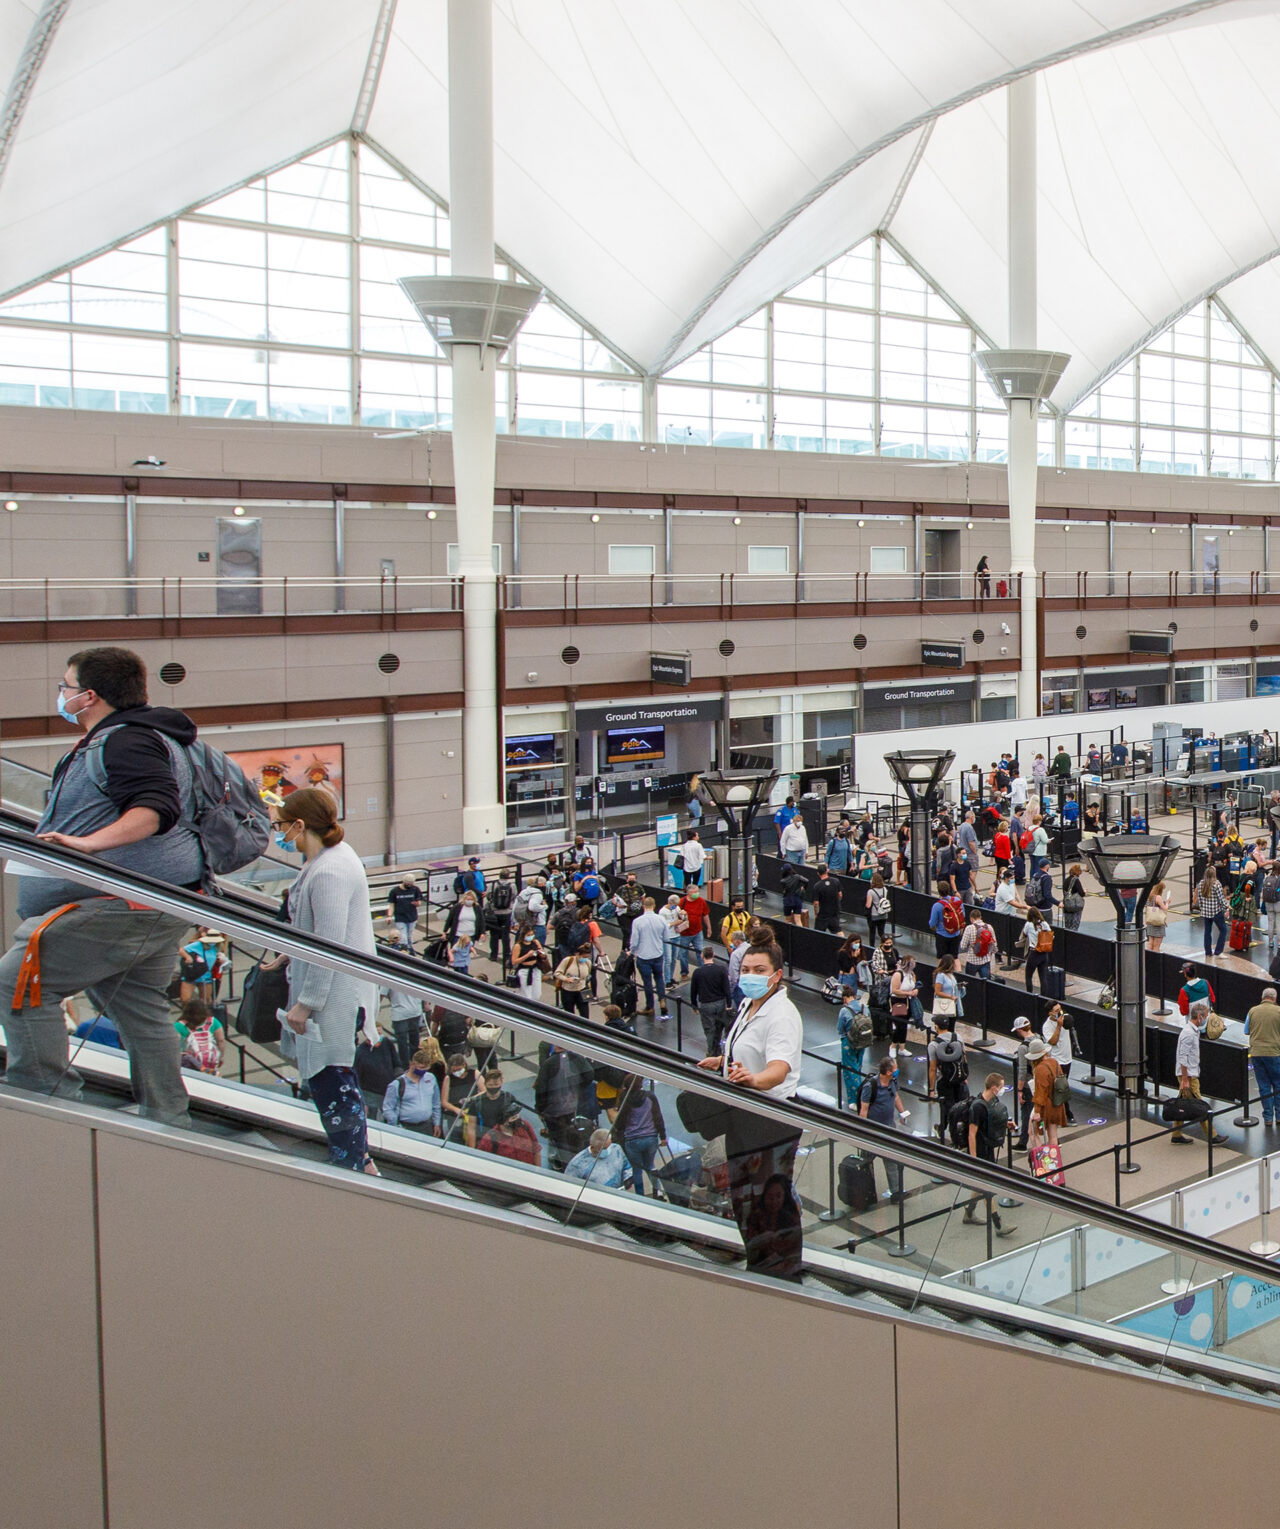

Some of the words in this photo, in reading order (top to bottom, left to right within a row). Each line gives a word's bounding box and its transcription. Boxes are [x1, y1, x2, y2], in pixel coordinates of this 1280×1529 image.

[884, 692, 909, 700] Ground
[910, 688, 955, 698] Transportation
[605, 712, 637, 722] Ground
[638, 708, 698, 719] Transportation
[1256, 1300, 1262, 1309] a
